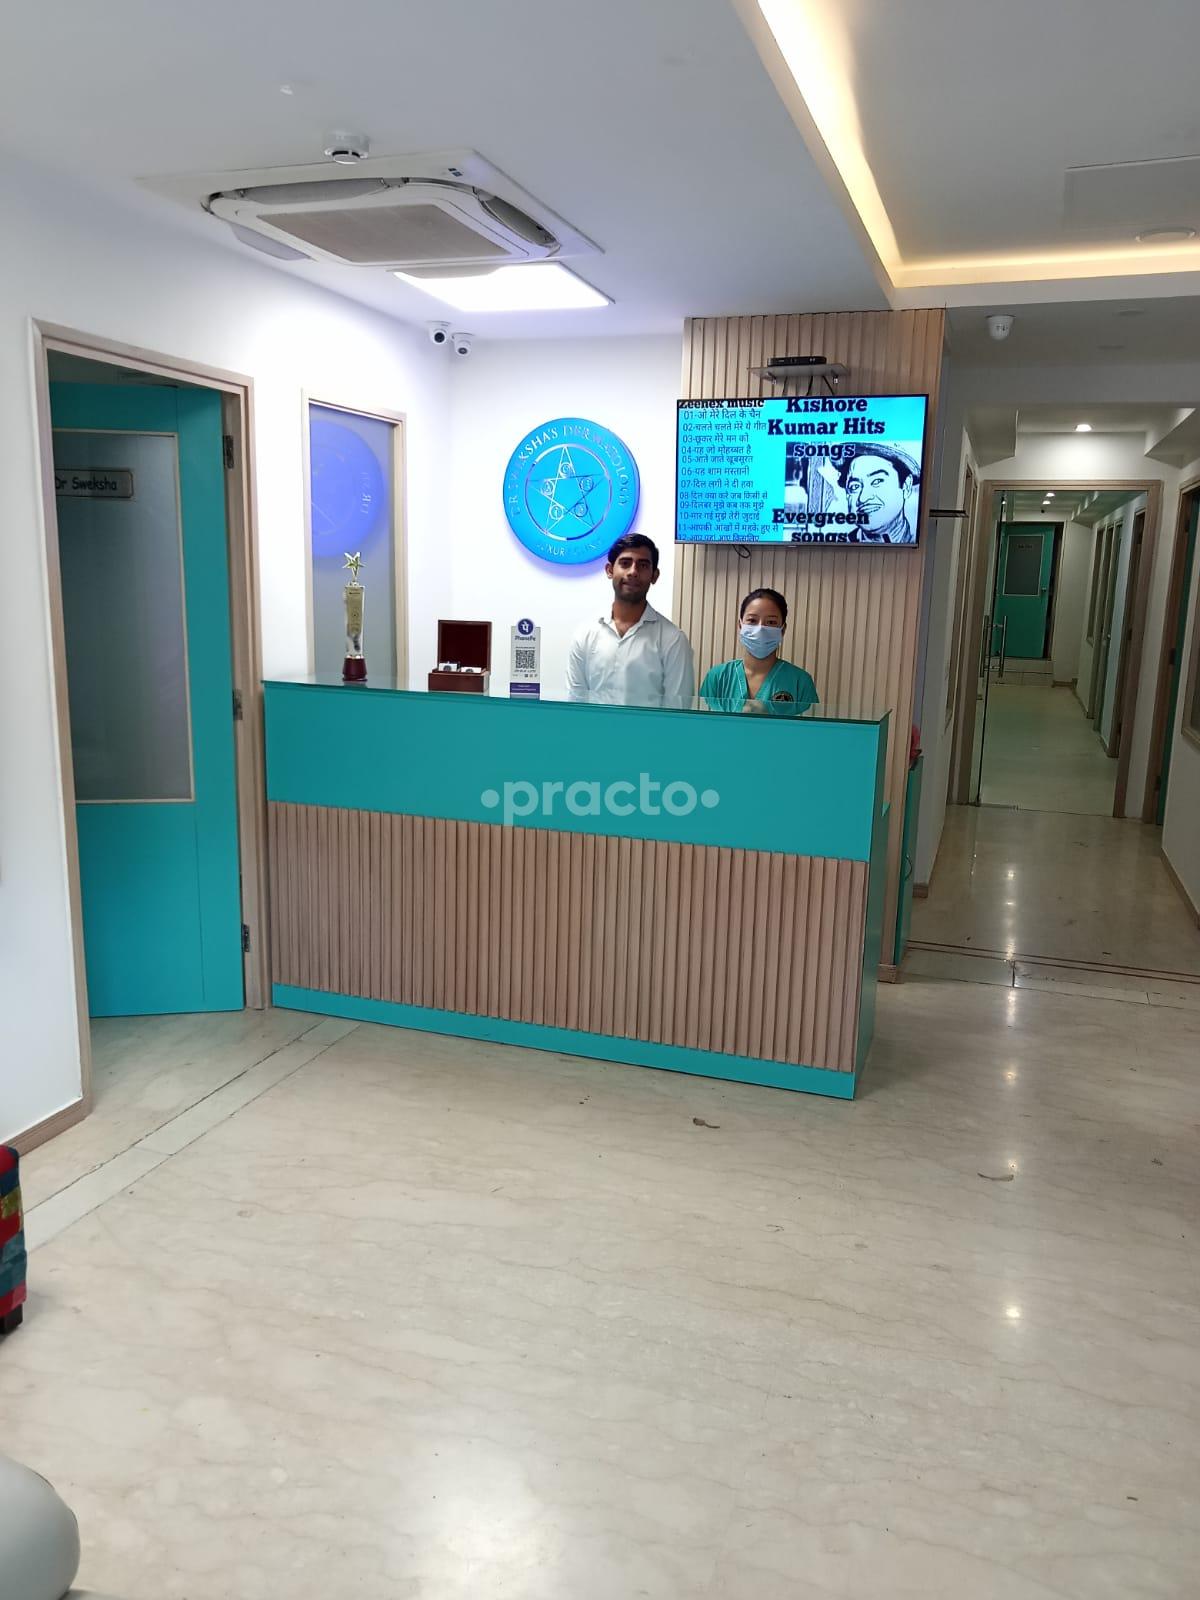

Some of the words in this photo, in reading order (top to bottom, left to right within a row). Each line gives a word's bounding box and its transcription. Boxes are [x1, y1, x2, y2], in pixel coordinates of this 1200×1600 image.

[728, 400, 765, 408] music
[786, 398, 867, 413] Kishore
[721, 409, 737, 420] दिल
[739, 408, 748, 419] के
[749, 408, 761, 418] चैन
[768, 418, 838, 436] Kumar
[843, 416, 885, 435] Hits
[739, 433, 749, 443] को
[746, 444, 752, 455] है
[793, 443, 856, 460] songs
[708, 467, 722, 476] शाम
[72, 475, 117, 491] Sweksha
[708, 479, 722, 488] लगी
[732, 479, 739, 488] दी
[743, 491, 760, 499] किसी
[773, 509, 870, 527] Evergreen
[791, 532, 850, 542] songs
